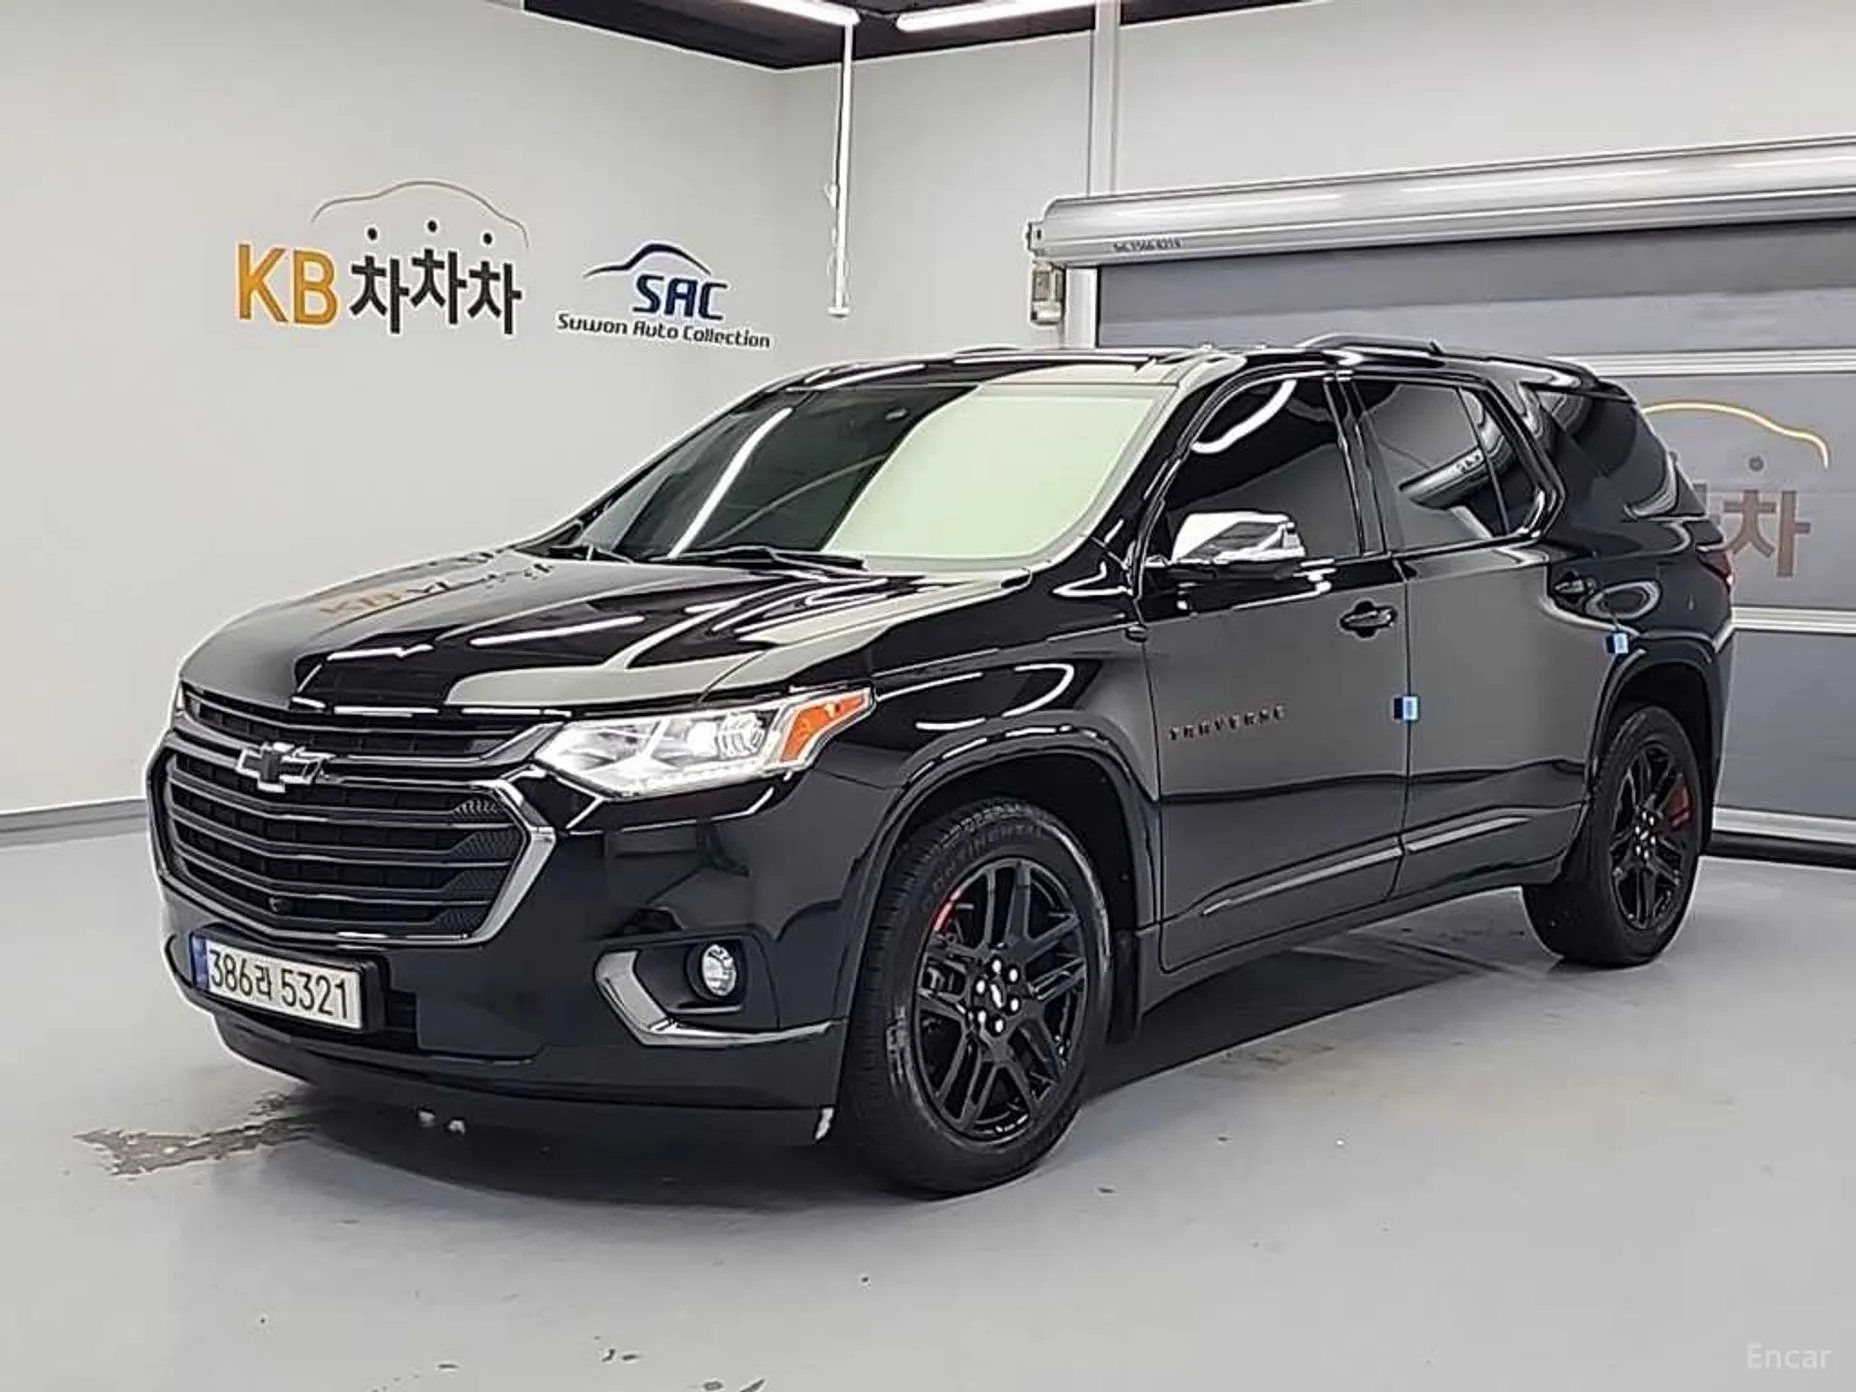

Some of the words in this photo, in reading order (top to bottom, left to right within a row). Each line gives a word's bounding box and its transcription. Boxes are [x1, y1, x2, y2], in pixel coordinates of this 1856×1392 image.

[632, 274, 728, 321] SAC
[557, 312, 628, 335] Suwon
[632, 320, 679, 340] Auto
[682, 326, 771, 348] Collection
[208, 949, 273, 1001] 386라
[281, 967, 349, 1019] 5321
